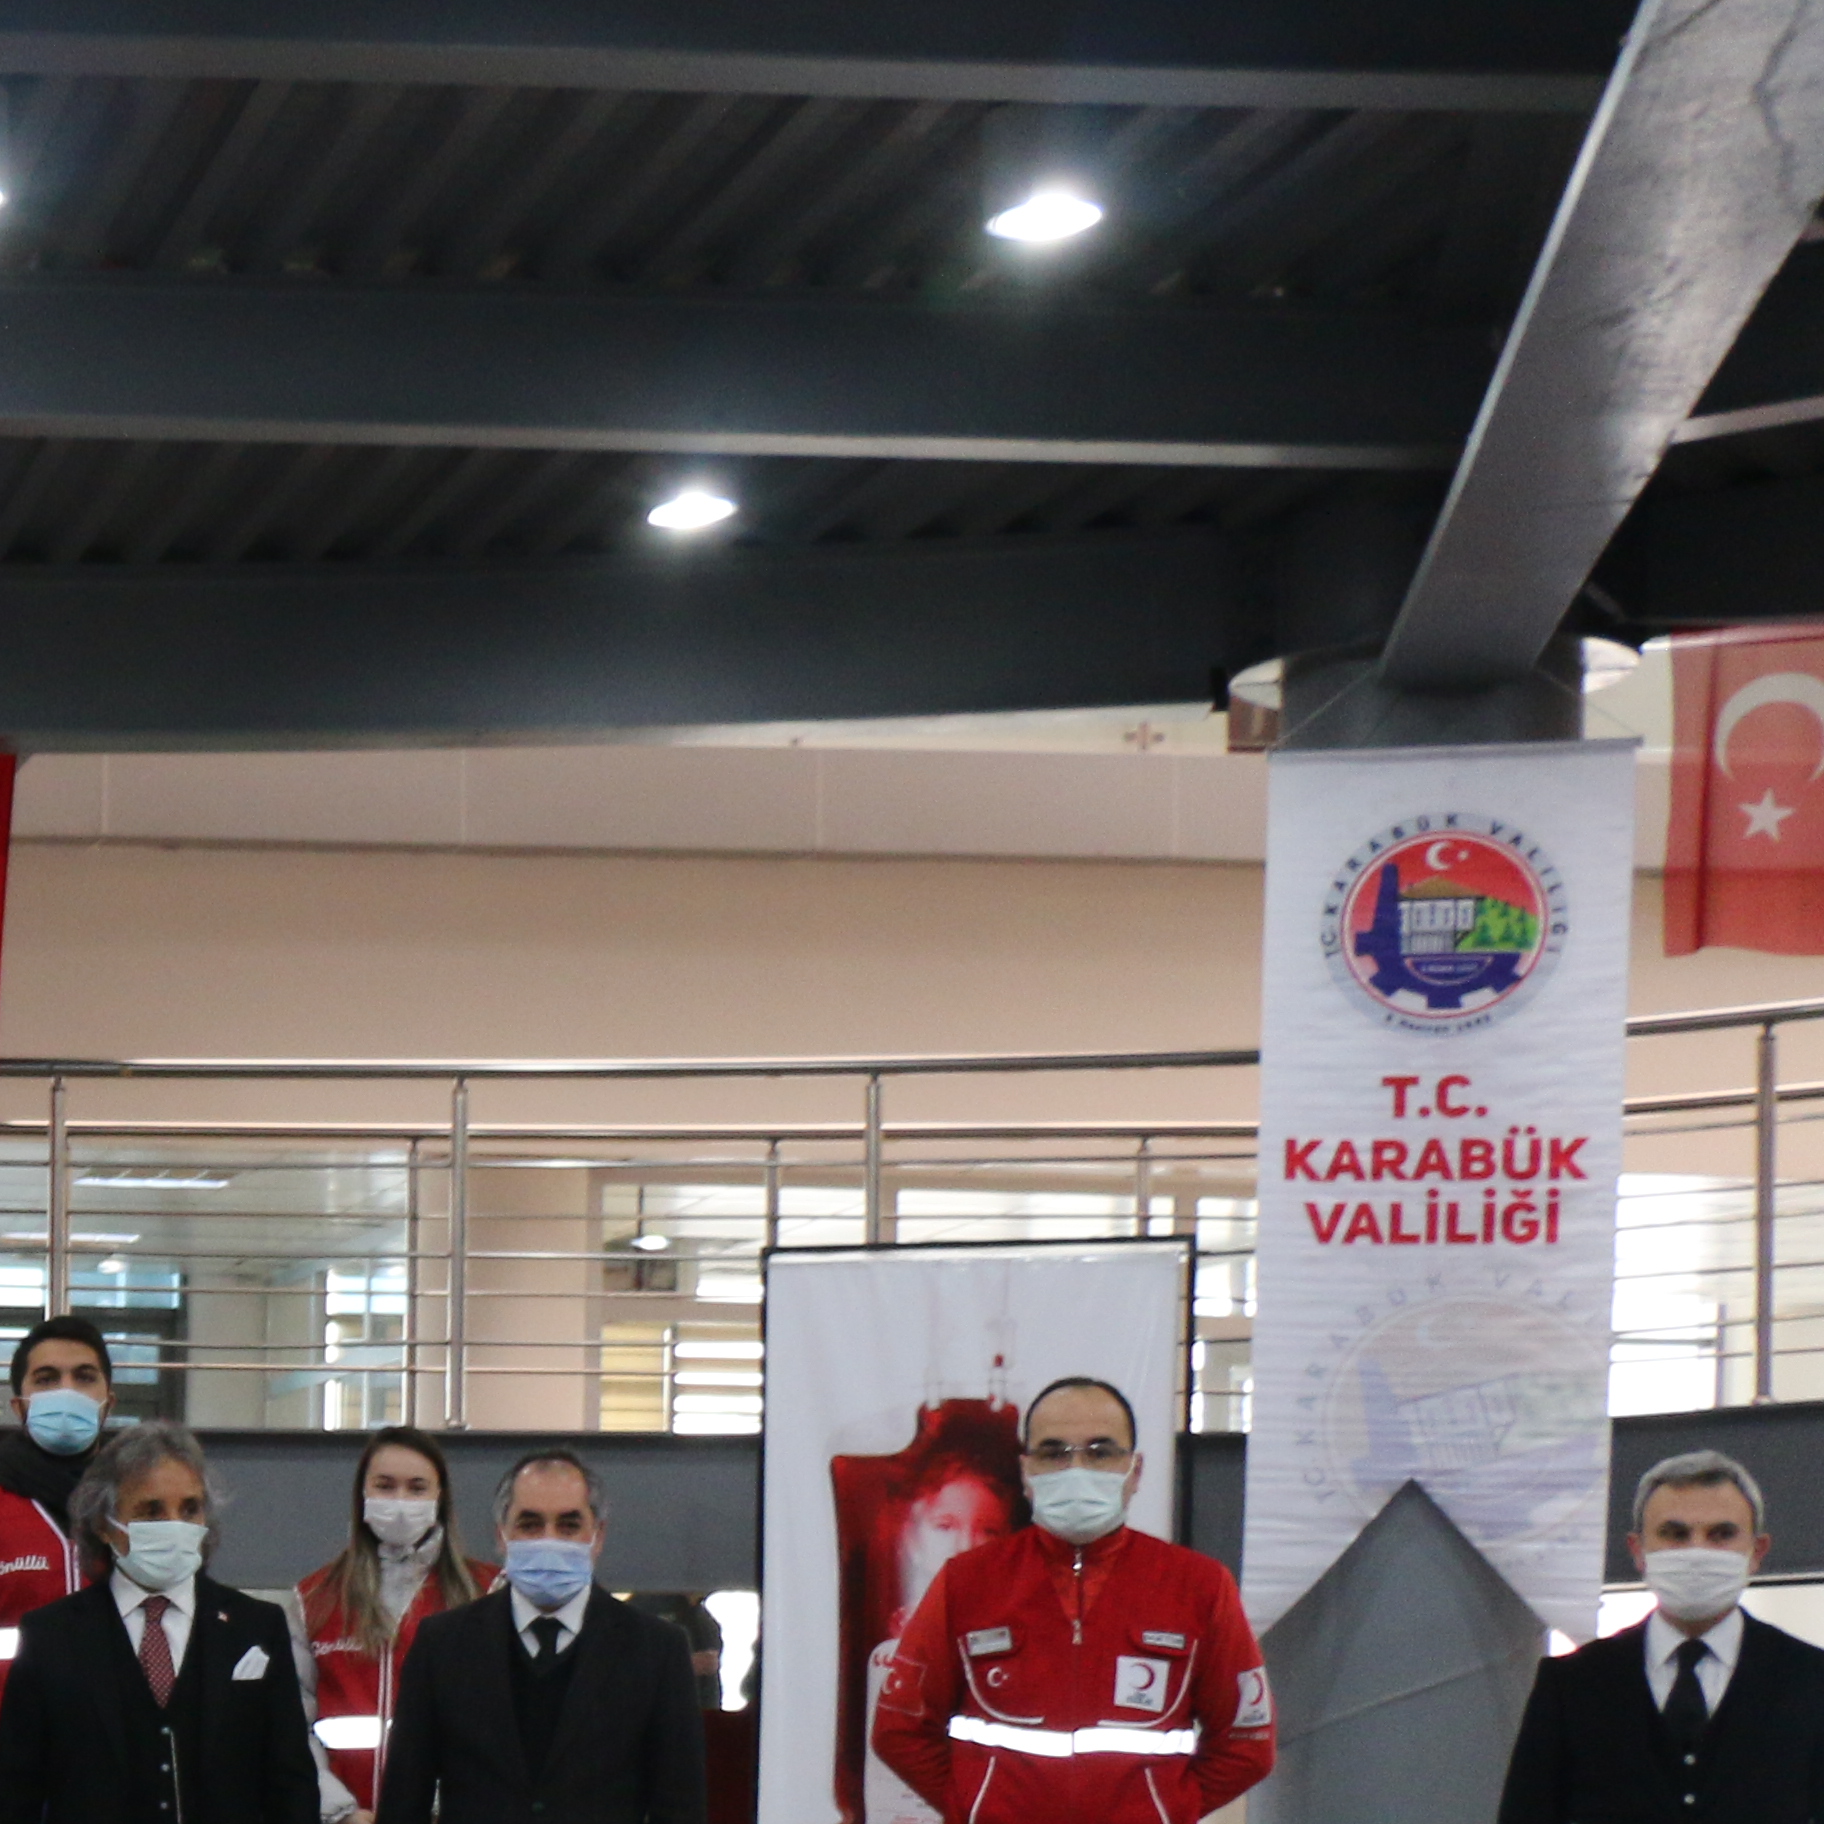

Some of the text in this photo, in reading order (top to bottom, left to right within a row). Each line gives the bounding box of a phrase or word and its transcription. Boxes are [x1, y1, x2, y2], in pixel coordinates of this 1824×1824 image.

[1381, 1075, 1488, 1119] T.C.
[1283, 1126, 1591, 1181] KARABÜK
[1304, 1187, 1562, 1245] VALİLİĞİ
